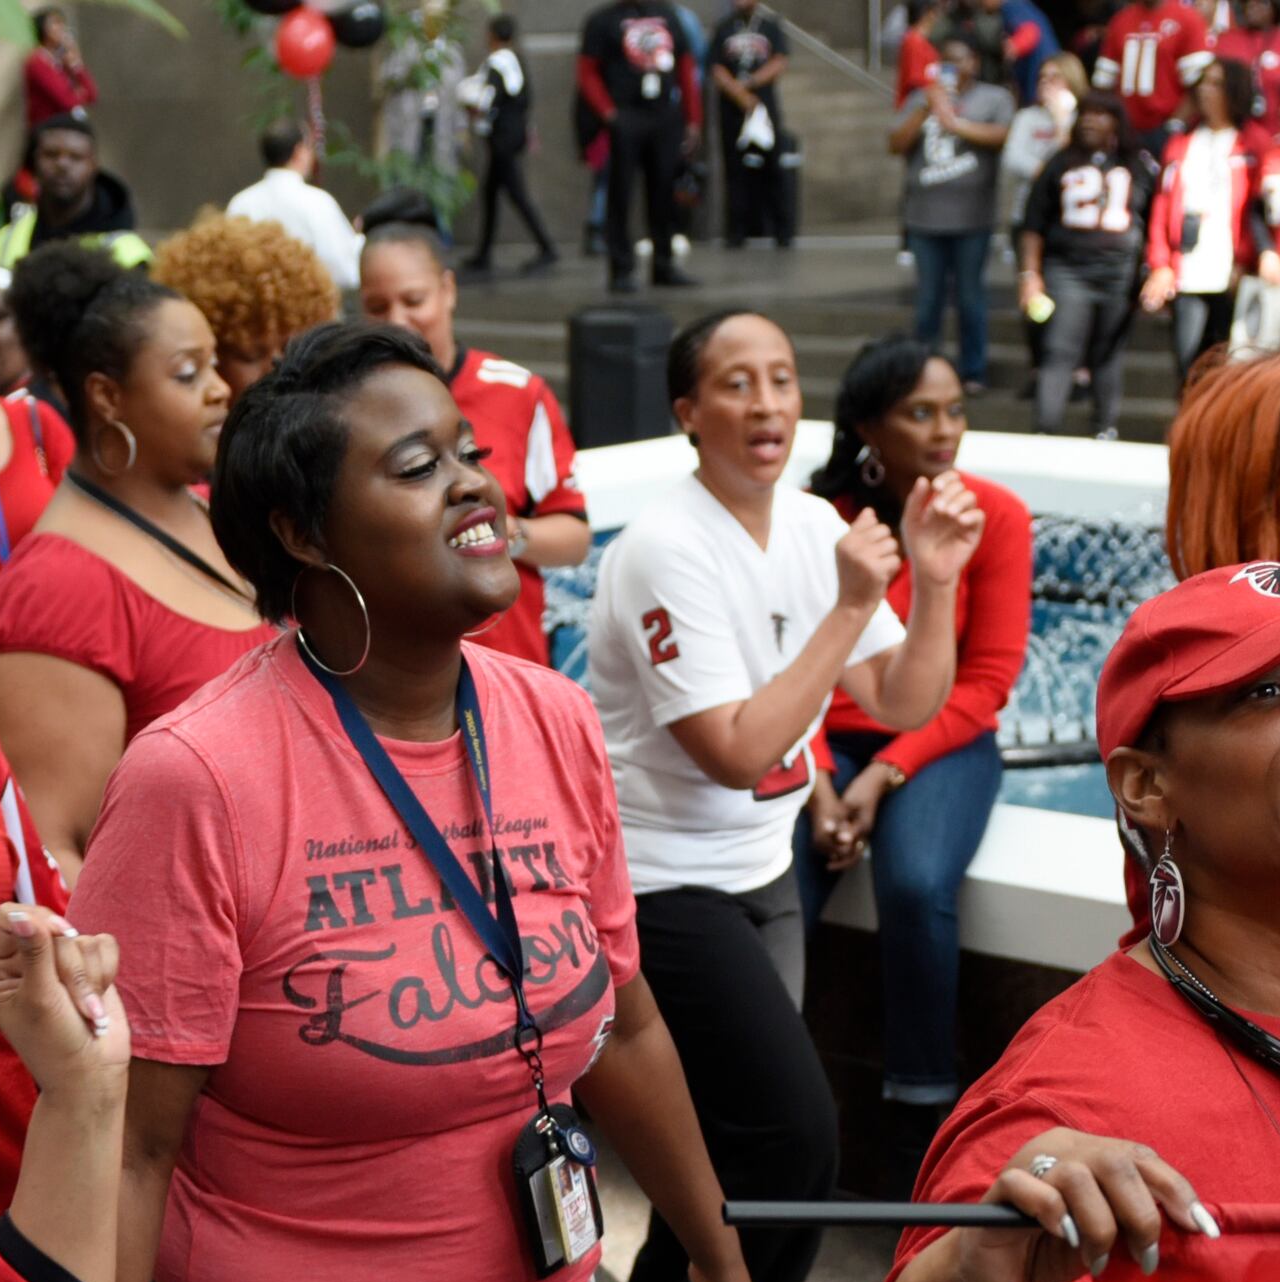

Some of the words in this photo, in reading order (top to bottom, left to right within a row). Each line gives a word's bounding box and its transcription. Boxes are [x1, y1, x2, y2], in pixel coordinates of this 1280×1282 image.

[1061, 165, 1132, 232] 21
[641, 607, 680, 667] 2
[304, 830, 398, 861] National
[404, 816, 483, 849] Ftball
[491, 814, 549, 839] League
